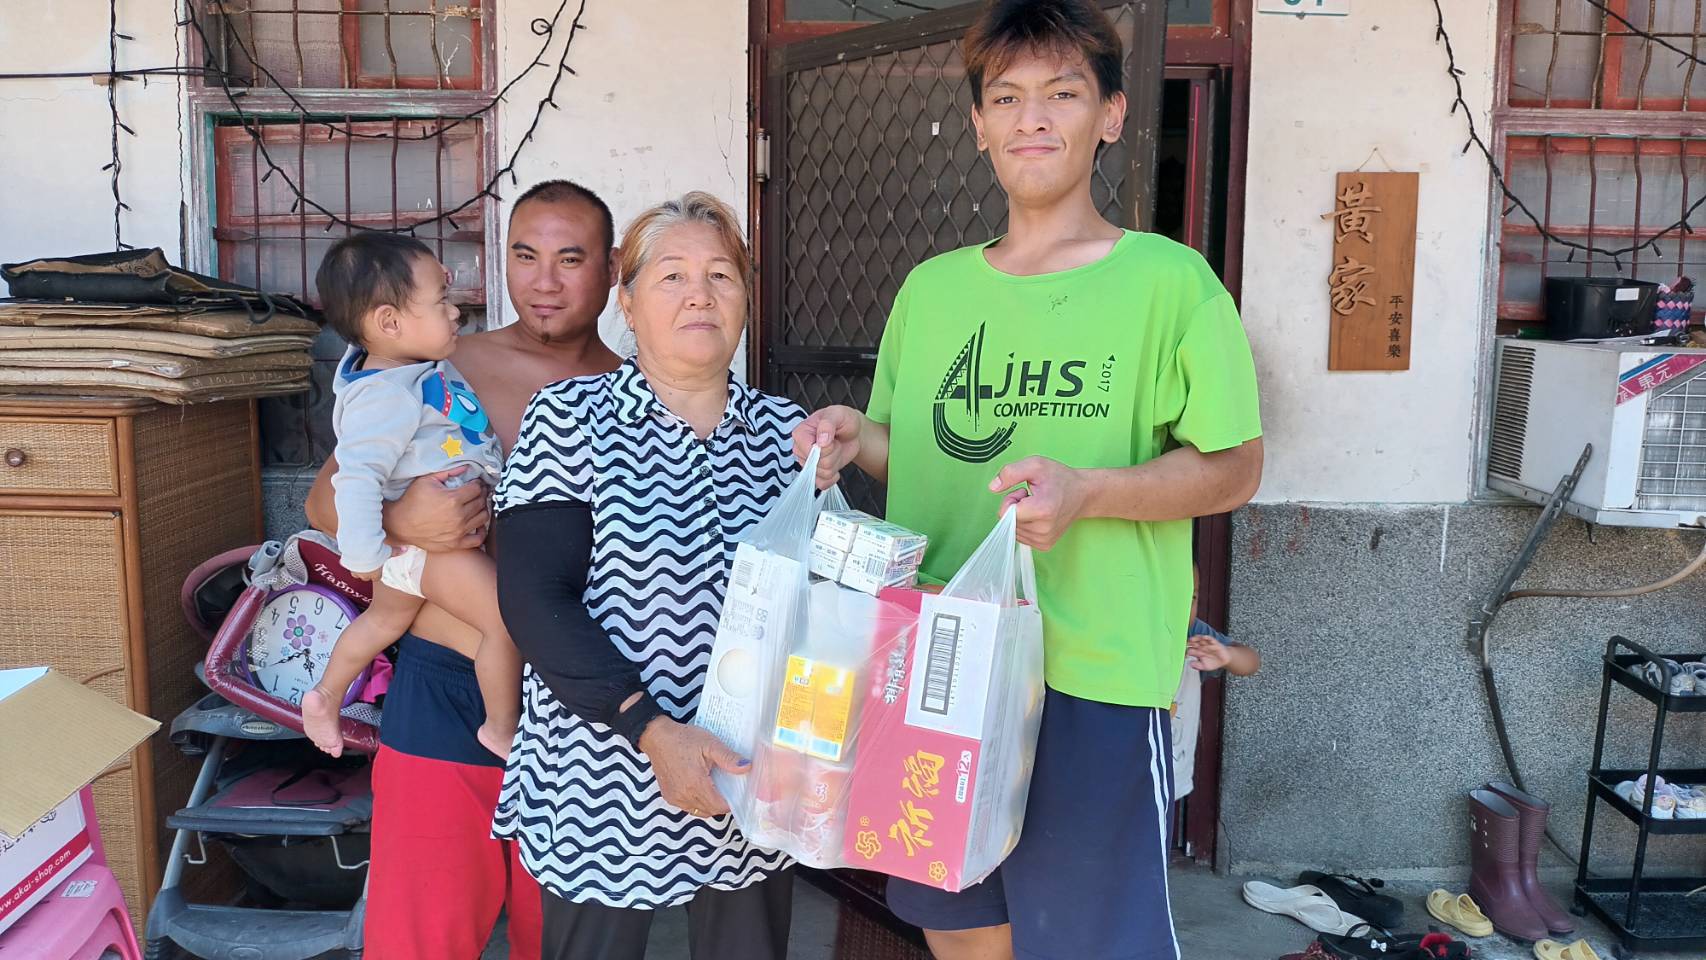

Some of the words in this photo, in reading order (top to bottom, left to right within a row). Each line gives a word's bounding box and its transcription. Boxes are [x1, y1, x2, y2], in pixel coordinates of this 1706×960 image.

[1387, 295, 1403, 358] 平安喜樂
[1097, 363, 1113, 393] 2017
[1638, 363, 1673, 390] 東元
[993, 402, 1111, 418] COMPETITION
[888, 749, 944, 857] 祈福
